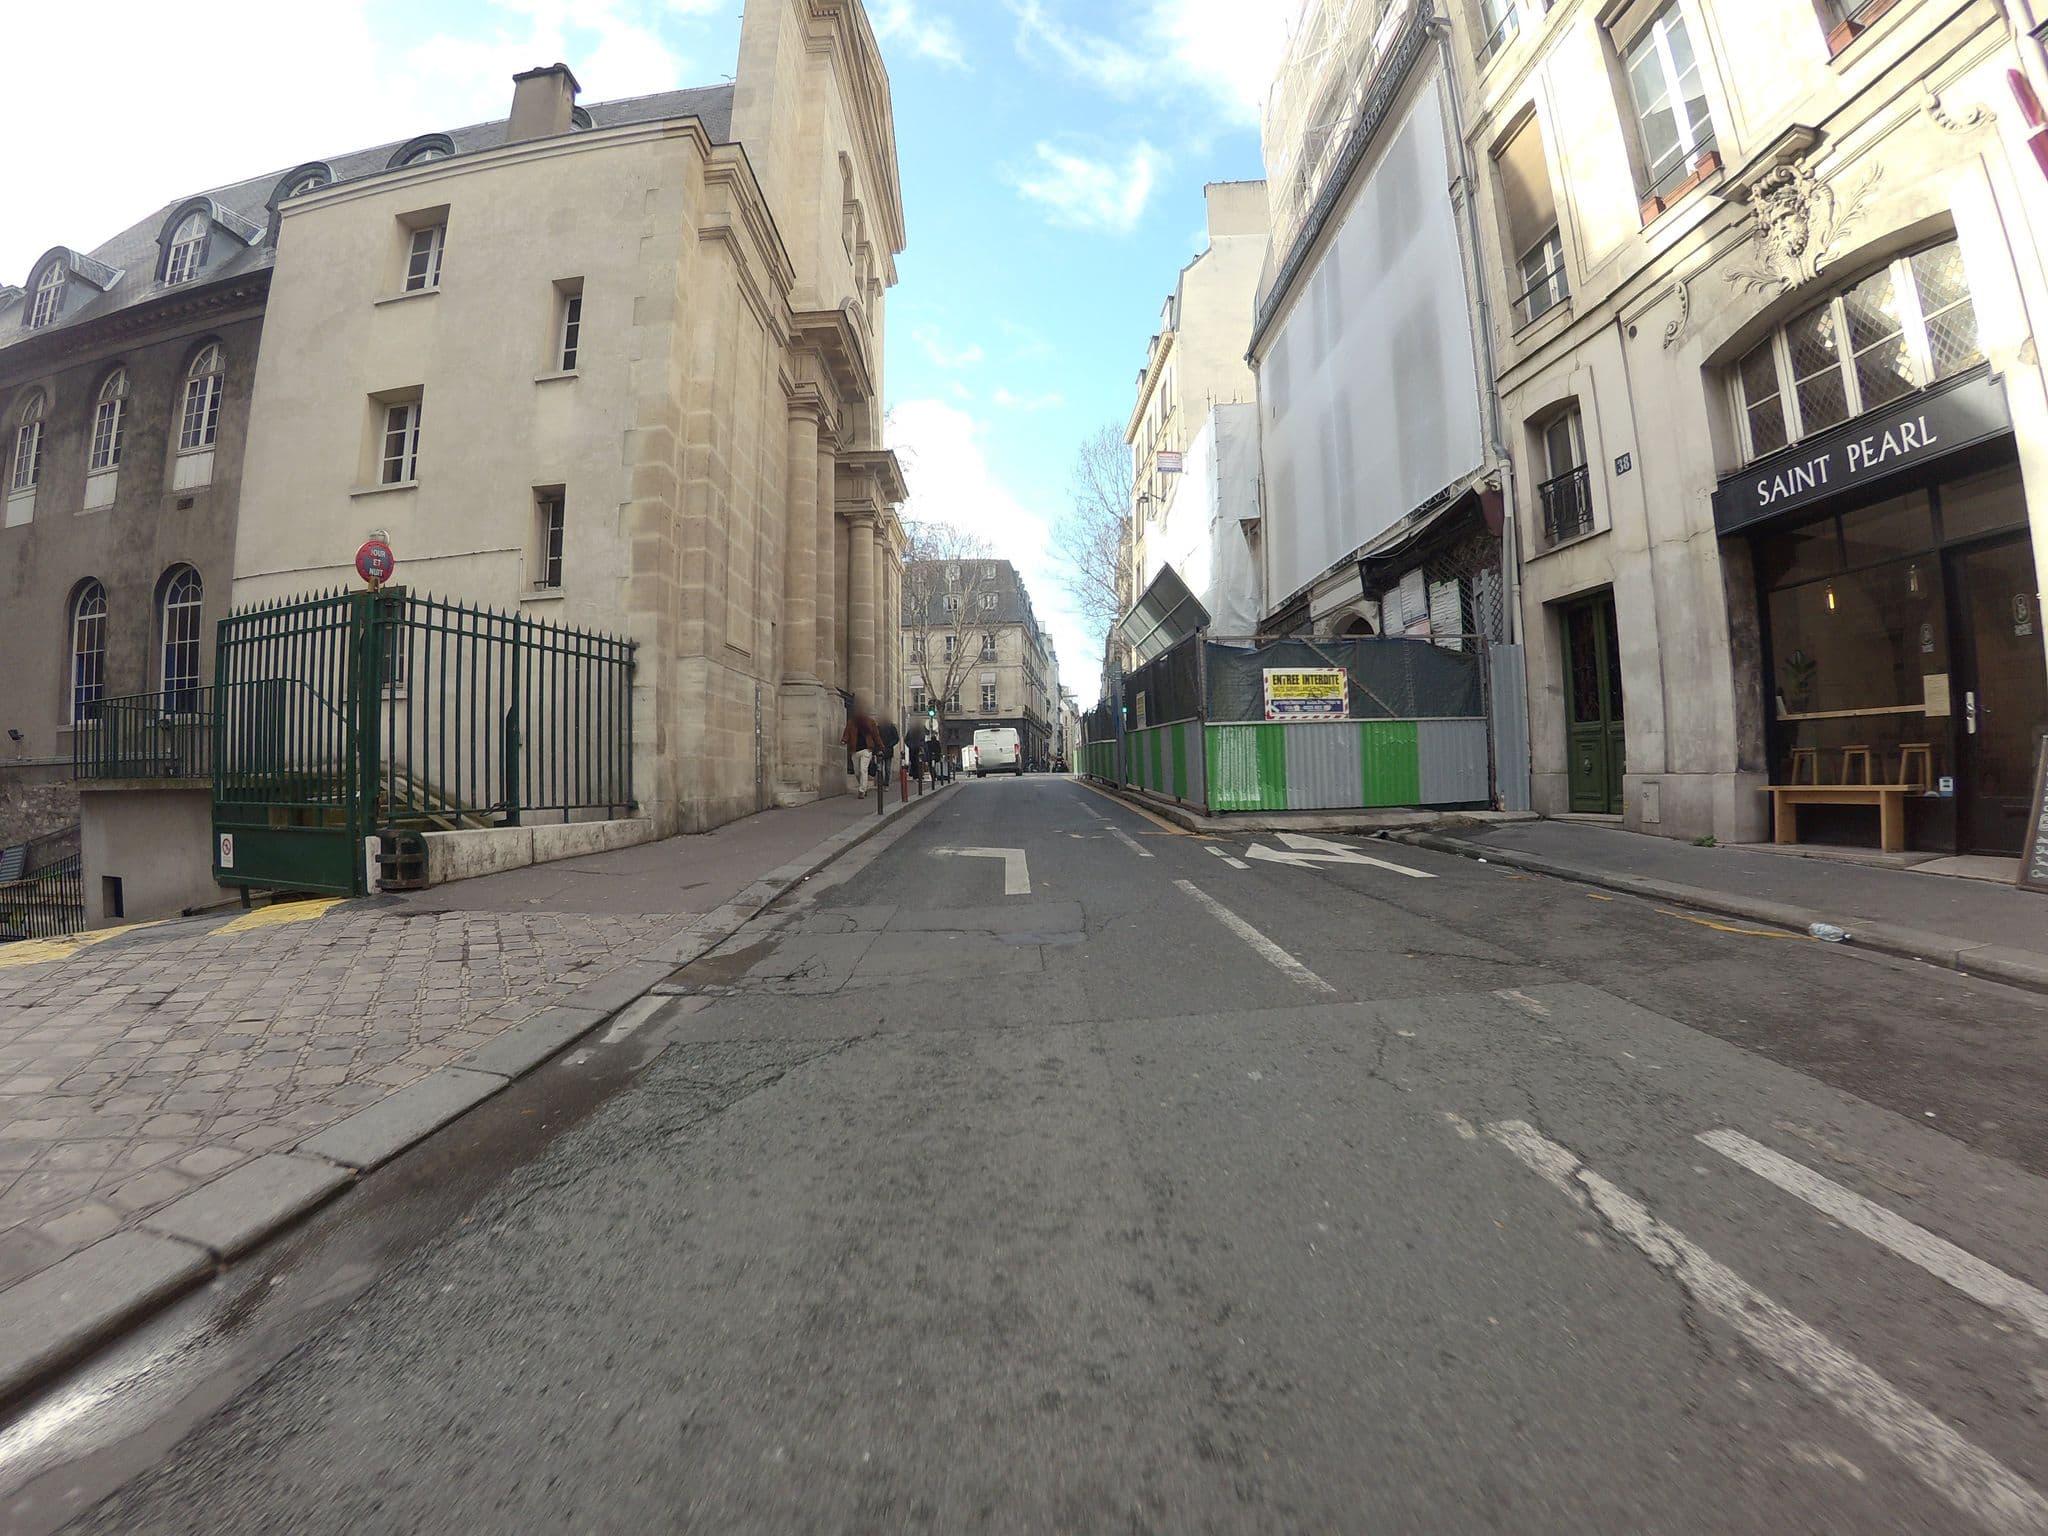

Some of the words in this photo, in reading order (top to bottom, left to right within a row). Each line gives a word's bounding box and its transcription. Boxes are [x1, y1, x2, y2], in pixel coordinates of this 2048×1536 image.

[1616, 455, 1630, 473] 38
[1756, 453, 1830, 506] SAINT
[1846, 414, 1938, 473] PEARL
[368, 567, 384, 576] NUIT
[1302, 674, 1340, 685] INTERDITE
